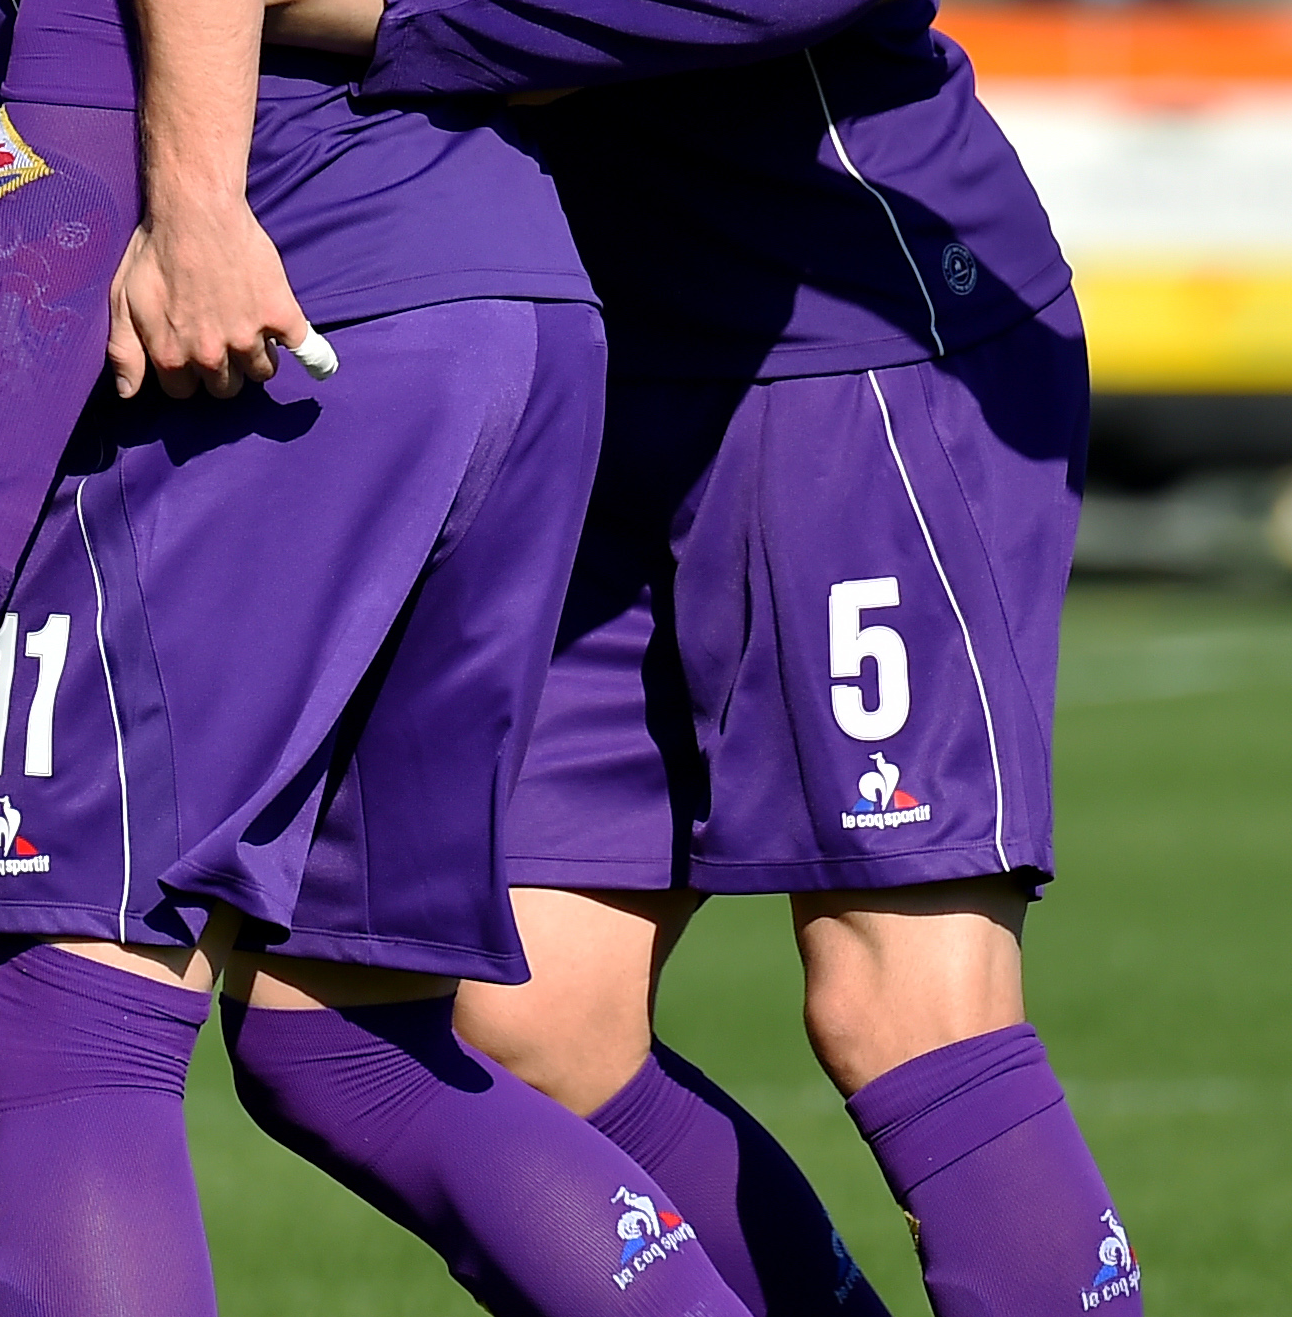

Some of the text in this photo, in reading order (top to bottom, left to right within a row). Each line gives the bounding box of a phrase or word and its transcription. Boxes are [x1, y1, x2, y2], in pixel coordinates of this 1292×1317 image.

[828, 576, 911, 742] 5
[841, 804, 931, 830] le coq sportif
[5, 854, 50, 876] sportif
[633, 1242, 667, 1272] coq
[1102, 1277, 1129, 1301] coq
